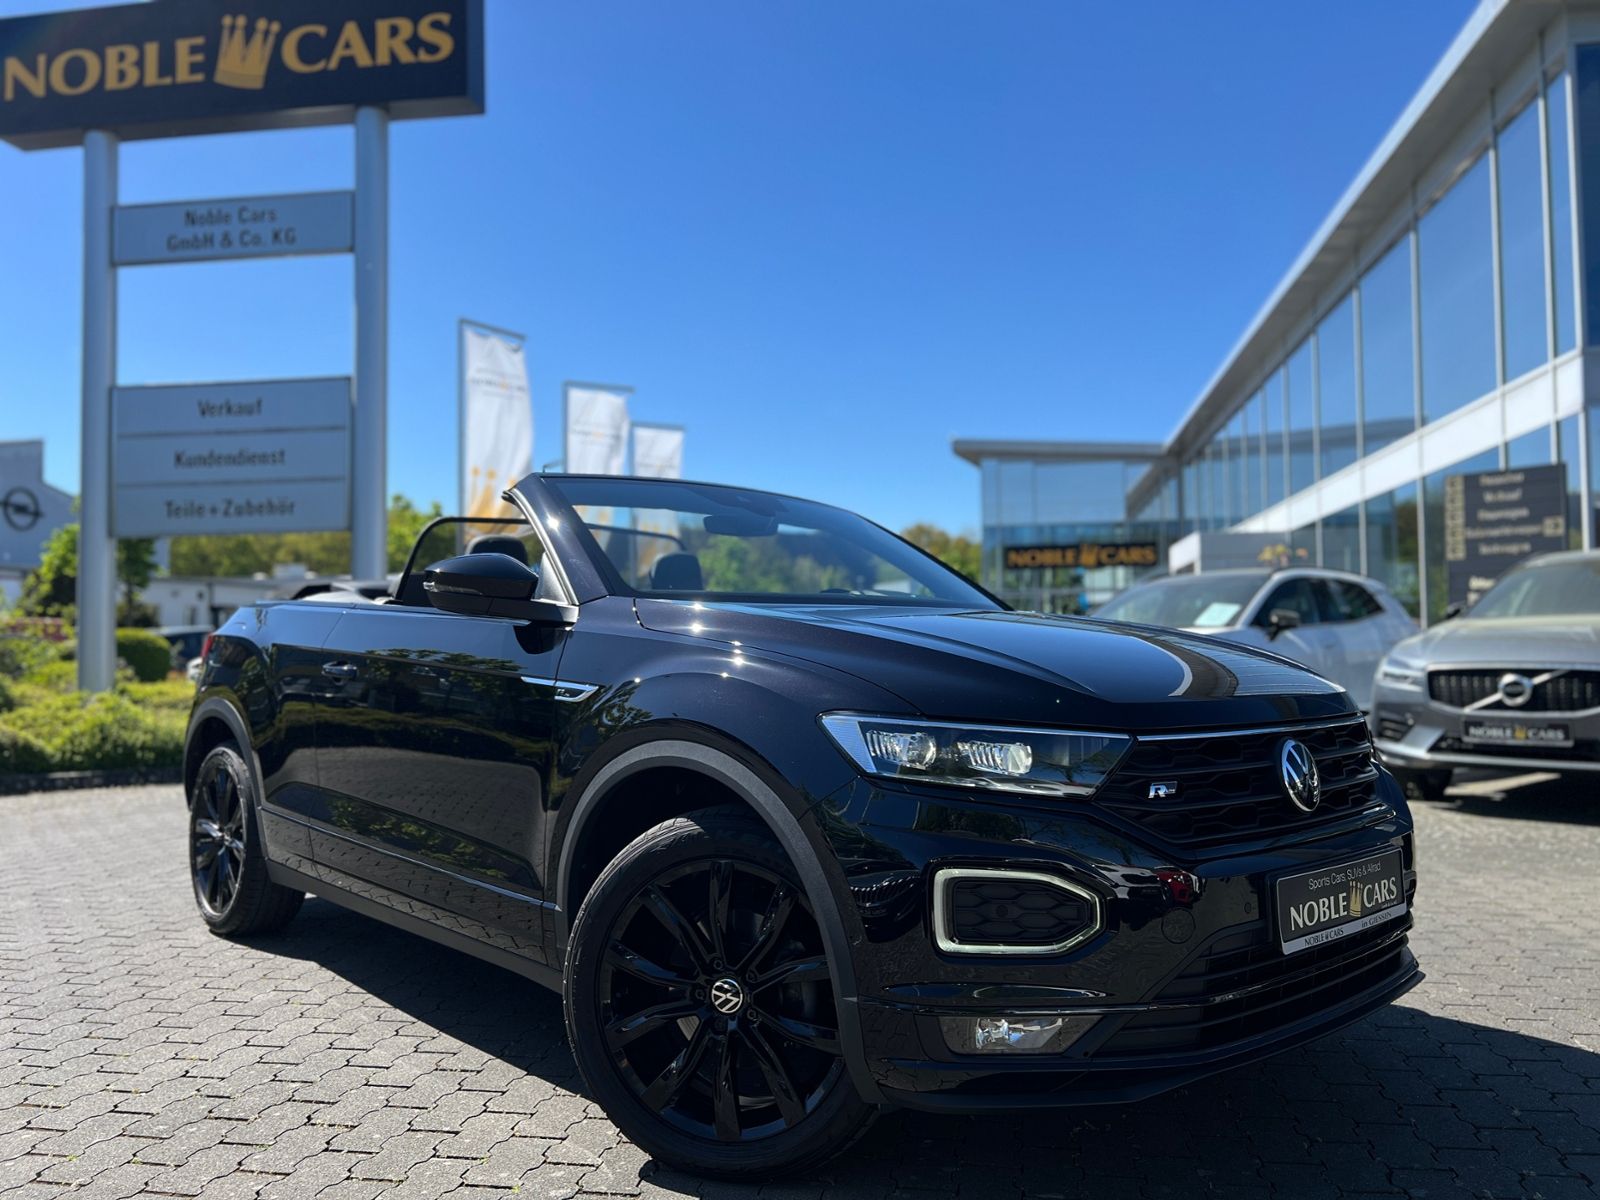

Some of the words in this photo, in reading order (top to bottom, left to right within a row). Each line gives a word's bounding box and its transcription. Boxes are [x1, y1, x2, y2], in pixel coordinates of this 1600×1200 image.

[3, 36, 206, 100] NOBLE
[281, 12, 455, 74] CARS
[184, 208, 232, 226] Noble
[237, 205, 277, 225] Cars
[166, 232, 215, 251] GmbH
[220, 230, 233, 248] &
[239, 228, 266, 247] Co.
[271, 226, 296, 245] KG
[197, 398, 263, 418] Verkauf
[174, 448, 286, 469] Kundendienst
[1007, 548, 1076, 567] NOBLE
[1101, 545, 1157, 566] CARS
[1468, 725, 1513, 738] NOBLE
[1528, 727, 1565, 740] CARS
[1308, 876, 1331, 891] Sports
[1290, 892, 1348, 931] NOBLE
[1363, 876, 1397, 908] CARS
[1304, 934, 1326, 947] NOBLE
[1328, 927, 1344, 940] CARS
